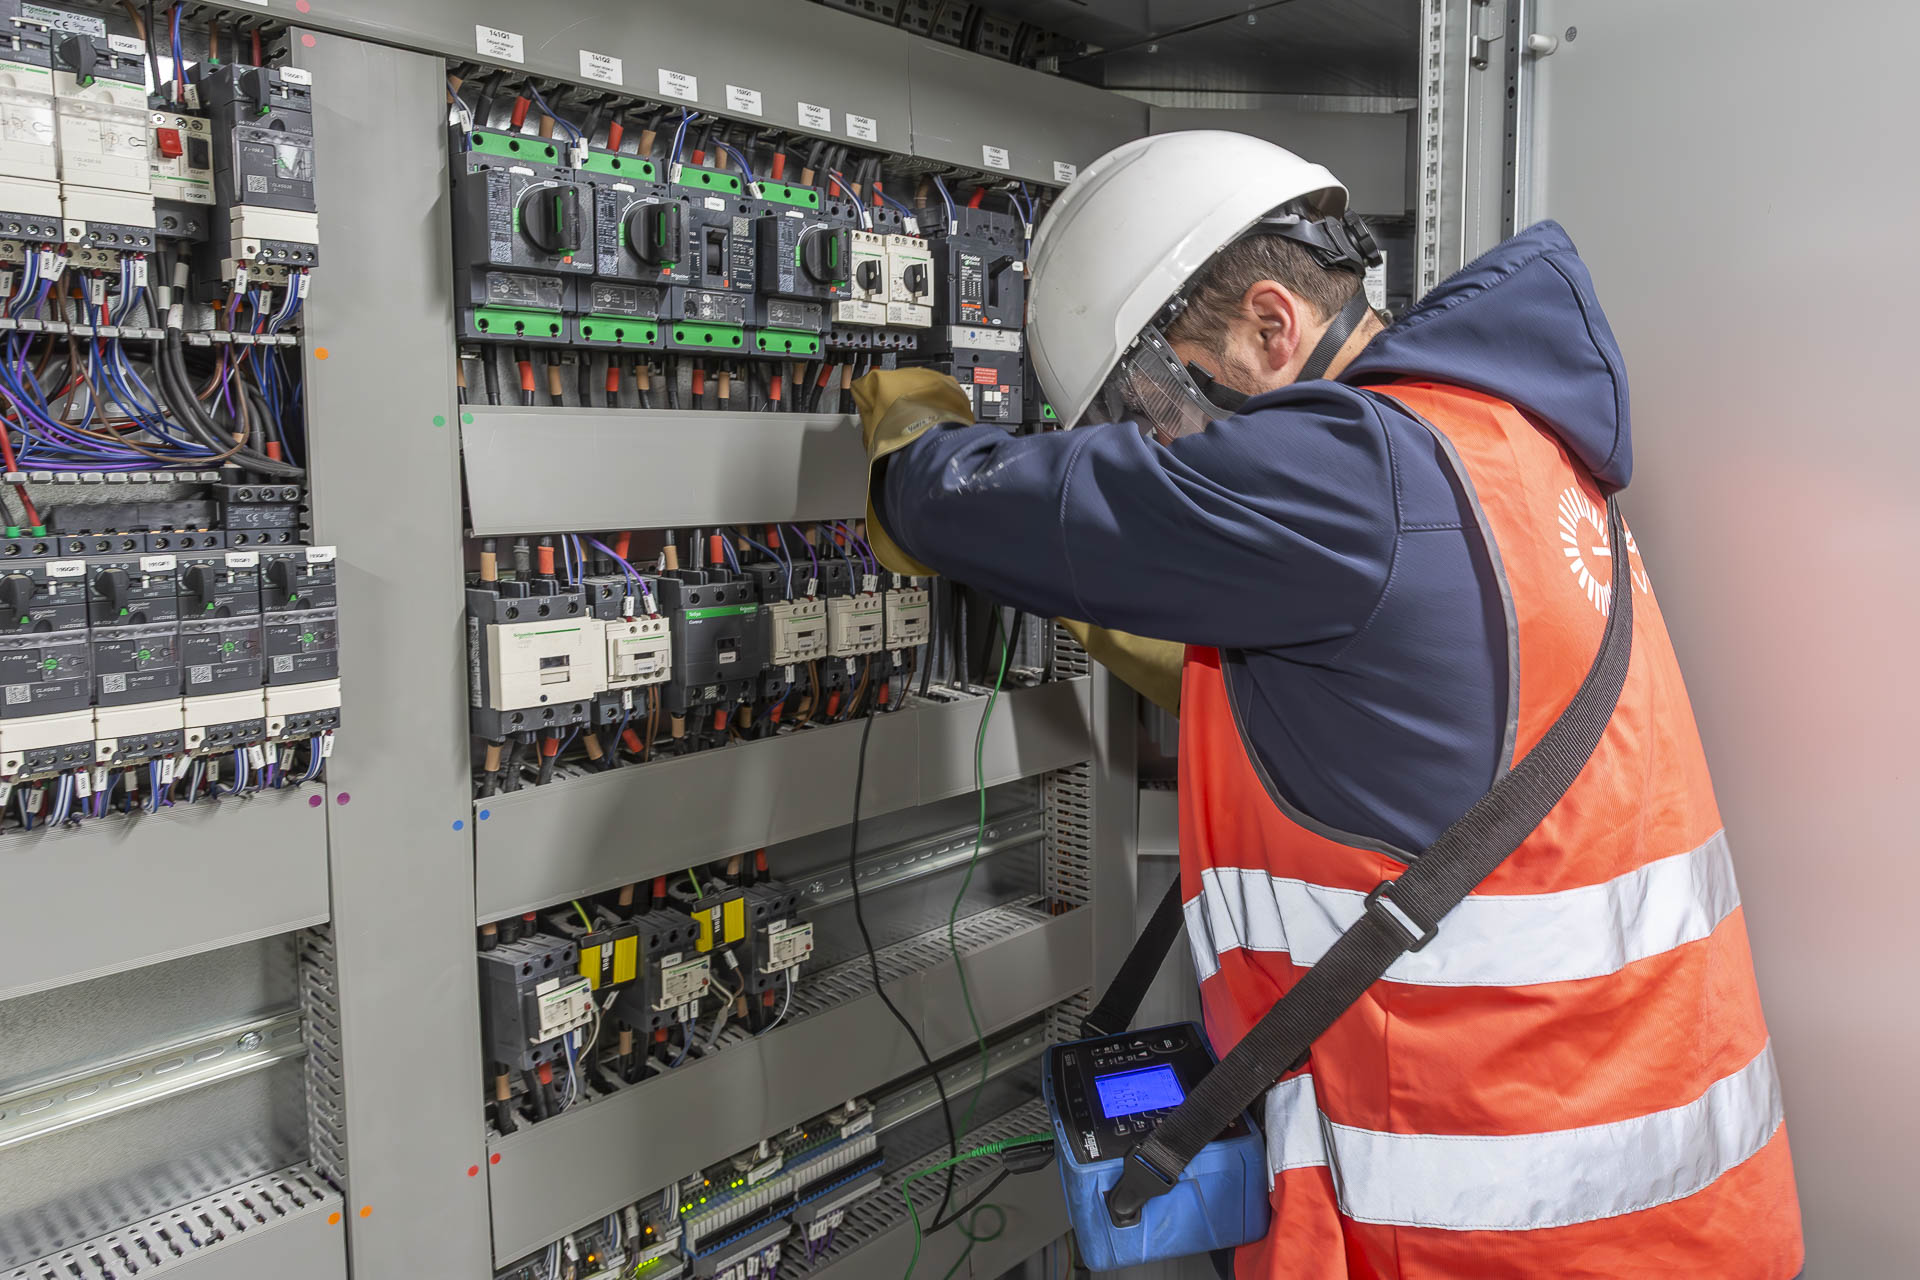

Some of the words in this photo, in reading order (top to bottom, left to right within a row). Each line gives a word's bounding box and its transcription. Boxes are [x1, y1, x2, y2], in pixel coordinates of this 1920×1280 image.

[489, 29, 510, 40] 141Q1
[592, 54, 611, 64] 141Q2
[961, 253, 981, 261] Schneider
